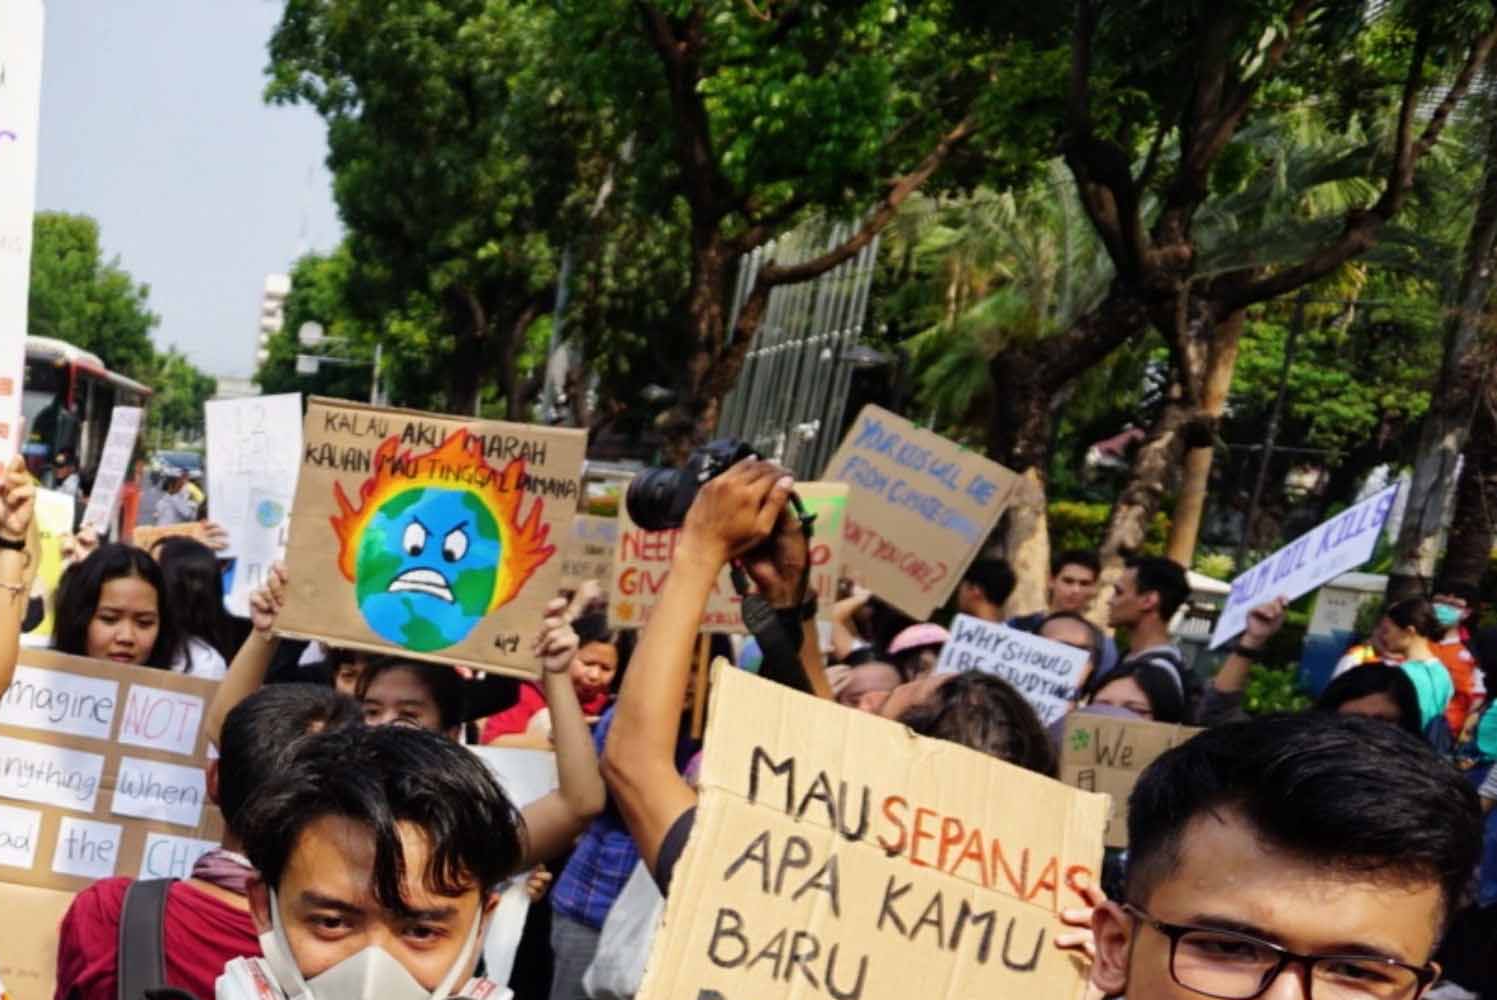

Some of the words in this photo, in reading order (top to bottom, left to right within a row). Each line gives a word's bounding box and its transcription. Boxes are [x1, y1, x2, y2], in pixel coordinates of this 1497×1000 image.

[324, 411, 389, 438] KALAU
[401, 421, 447, 448] AKU
[465, 434, 547, 465] MARAH
[381, 453, 418, 478] MAU
[429, 459, 508, 492] TINGGAL
[955, 619, 1004, 655] WHY
[1004, 640, 1073, 676] SHOULD
[123, 695, 199, 750] NOT
[1094, 728, 1134, 767] We
[65, 824, 113, 863] the
[747, 745, 872, 842] MAU
[876, 795, 1098, 908] SEPANAS
[724, 830, 840, 918] APA
[876, 875, 1046, 972] KAMU
